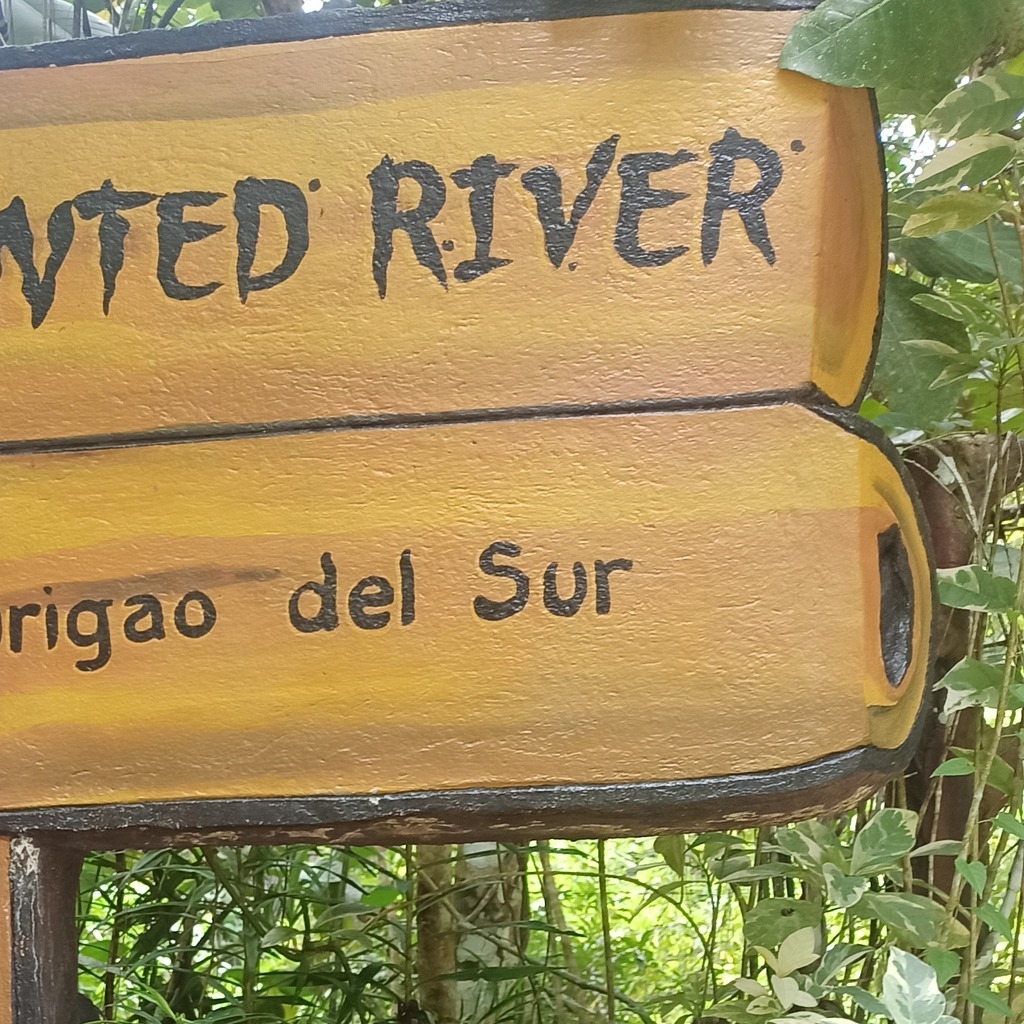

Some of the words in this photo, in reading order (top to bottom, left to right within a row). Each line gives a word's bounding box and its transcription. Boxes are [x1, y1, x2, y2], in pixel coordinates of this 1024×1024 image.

[370, 128, 783, 300] RIVER
[288, 549, 415, 633] del
[473, 541, 634, 621] Sur
